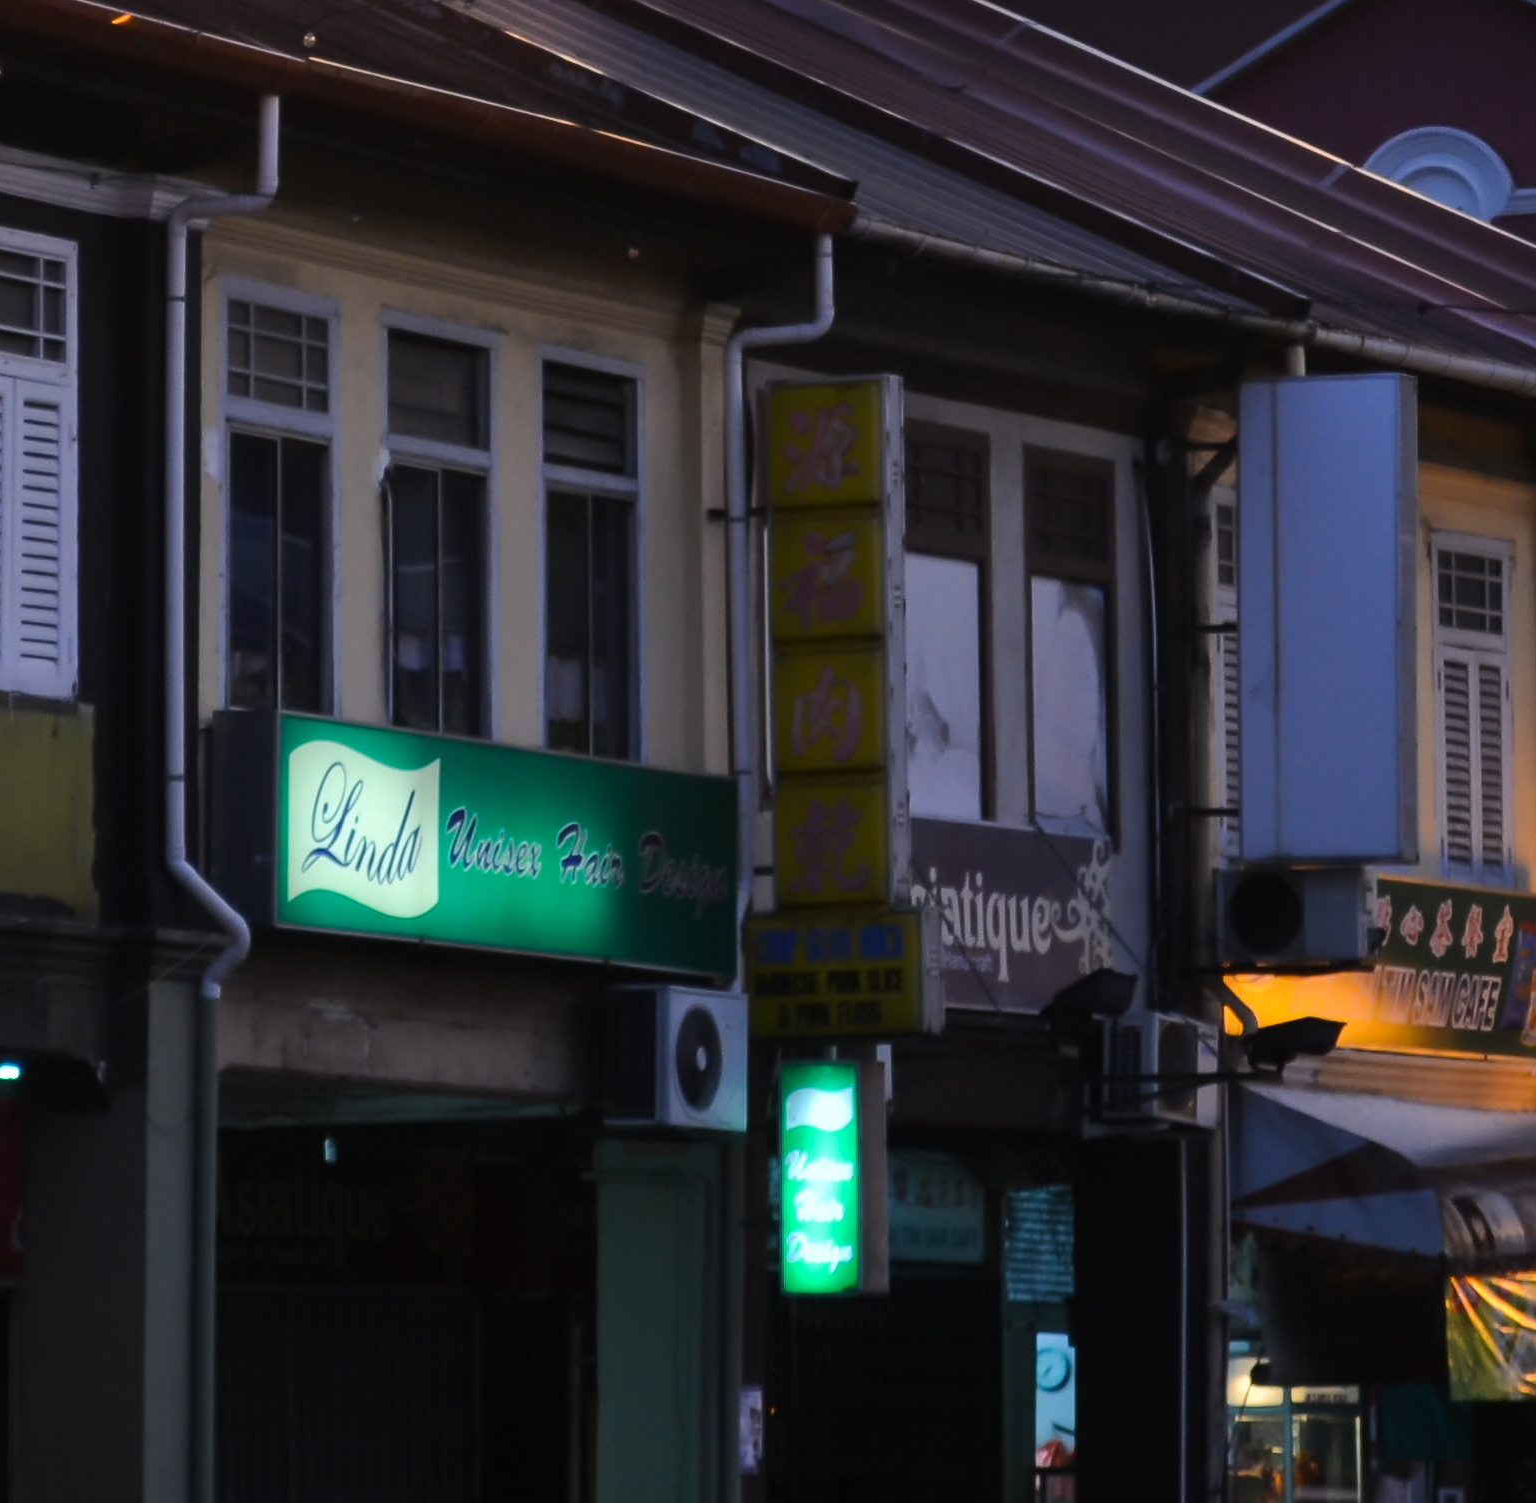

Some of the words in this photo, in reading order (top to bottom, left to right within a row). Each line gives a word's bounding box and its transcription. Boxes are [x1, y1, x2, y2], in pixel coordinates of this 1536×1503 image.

[301, 761, 423, 887] Linda
[445, 806, 543, 880] Unisex
[556, 821, 625, 890] Hair
[638, 830, 729, 921] Design
[1451, 973, 1503, 1032] CAFE
